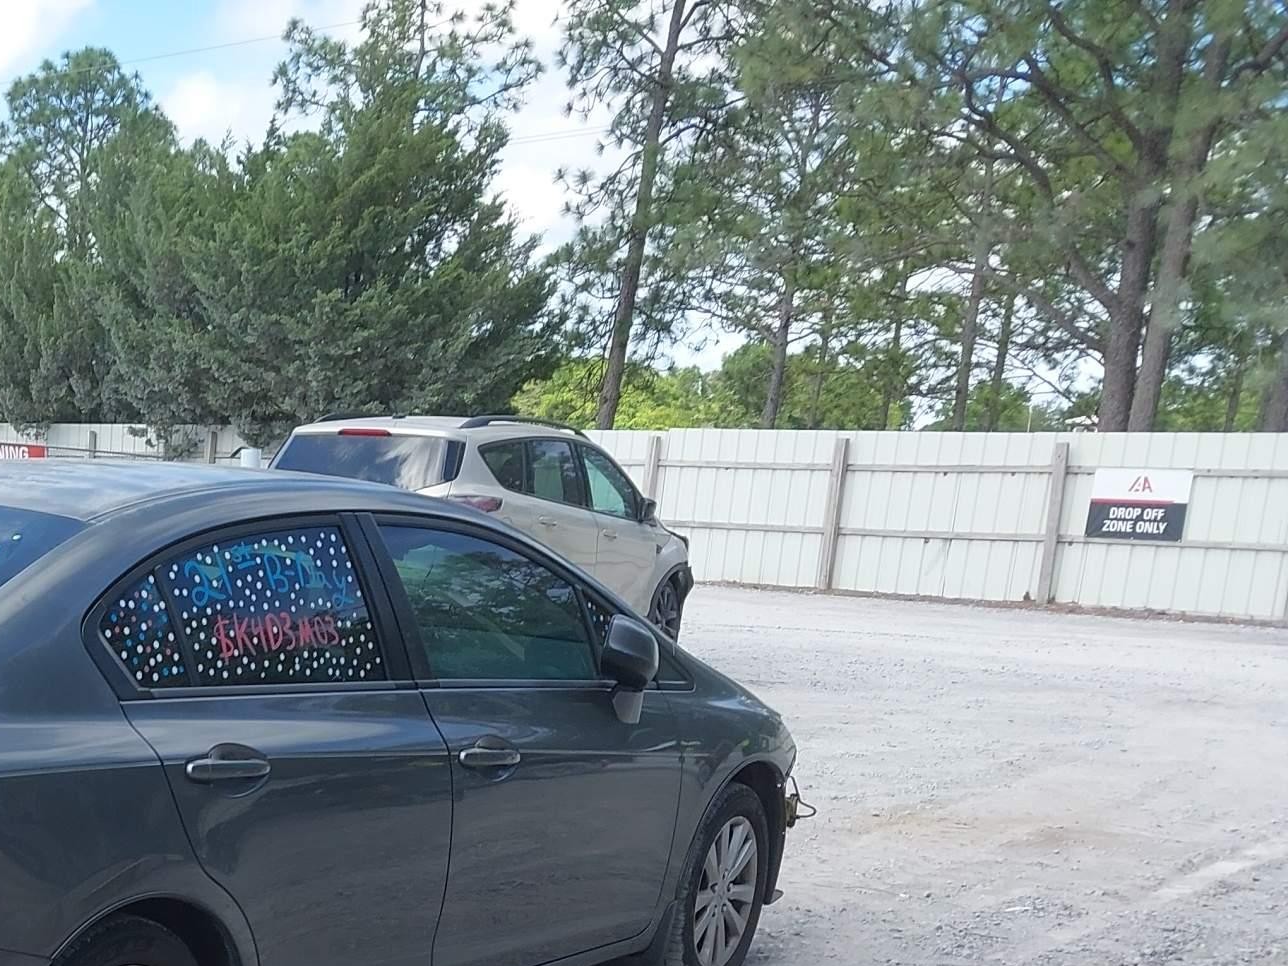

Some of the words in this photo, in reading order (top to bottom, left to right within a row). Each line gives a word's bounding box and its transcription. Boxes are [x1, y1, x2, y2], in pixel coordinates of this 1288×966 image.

[1109, 506, 1142, 520] DROP
[1143, 508, 1166, 520] OFF
[1102, 520, 1135, 532] ZONE
[1135, 521, 1167, 534] ONLY
